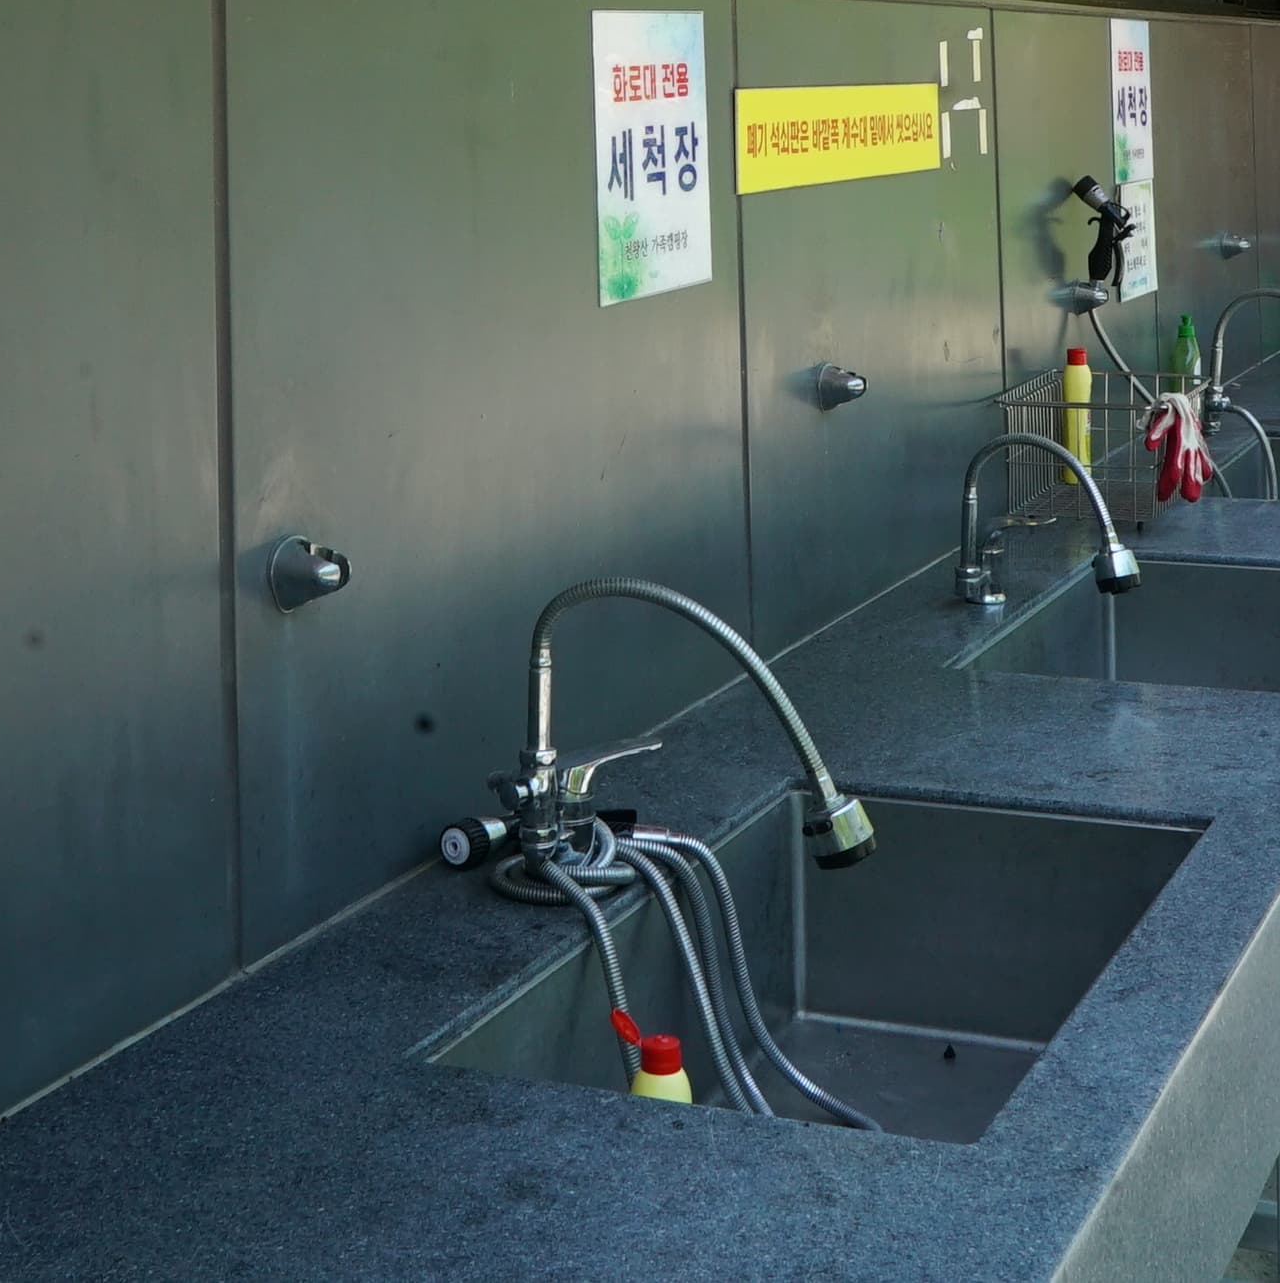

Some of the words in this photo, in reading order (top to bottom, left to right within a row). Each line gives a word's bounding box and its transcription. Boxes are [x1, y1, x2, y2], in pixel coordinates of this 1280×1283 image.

[612, 63, 657, 103] 화로대
[661, 62, 689, 98] 전용
[1117, 85, 1148, 127] 세척장
[770, 119, 809, 156] 석쇠판은
[869, 114, 894, 146] 밑에서
[607, 120, 699, 202] 세척장
[624, 237, 649, 261] 천왕산
